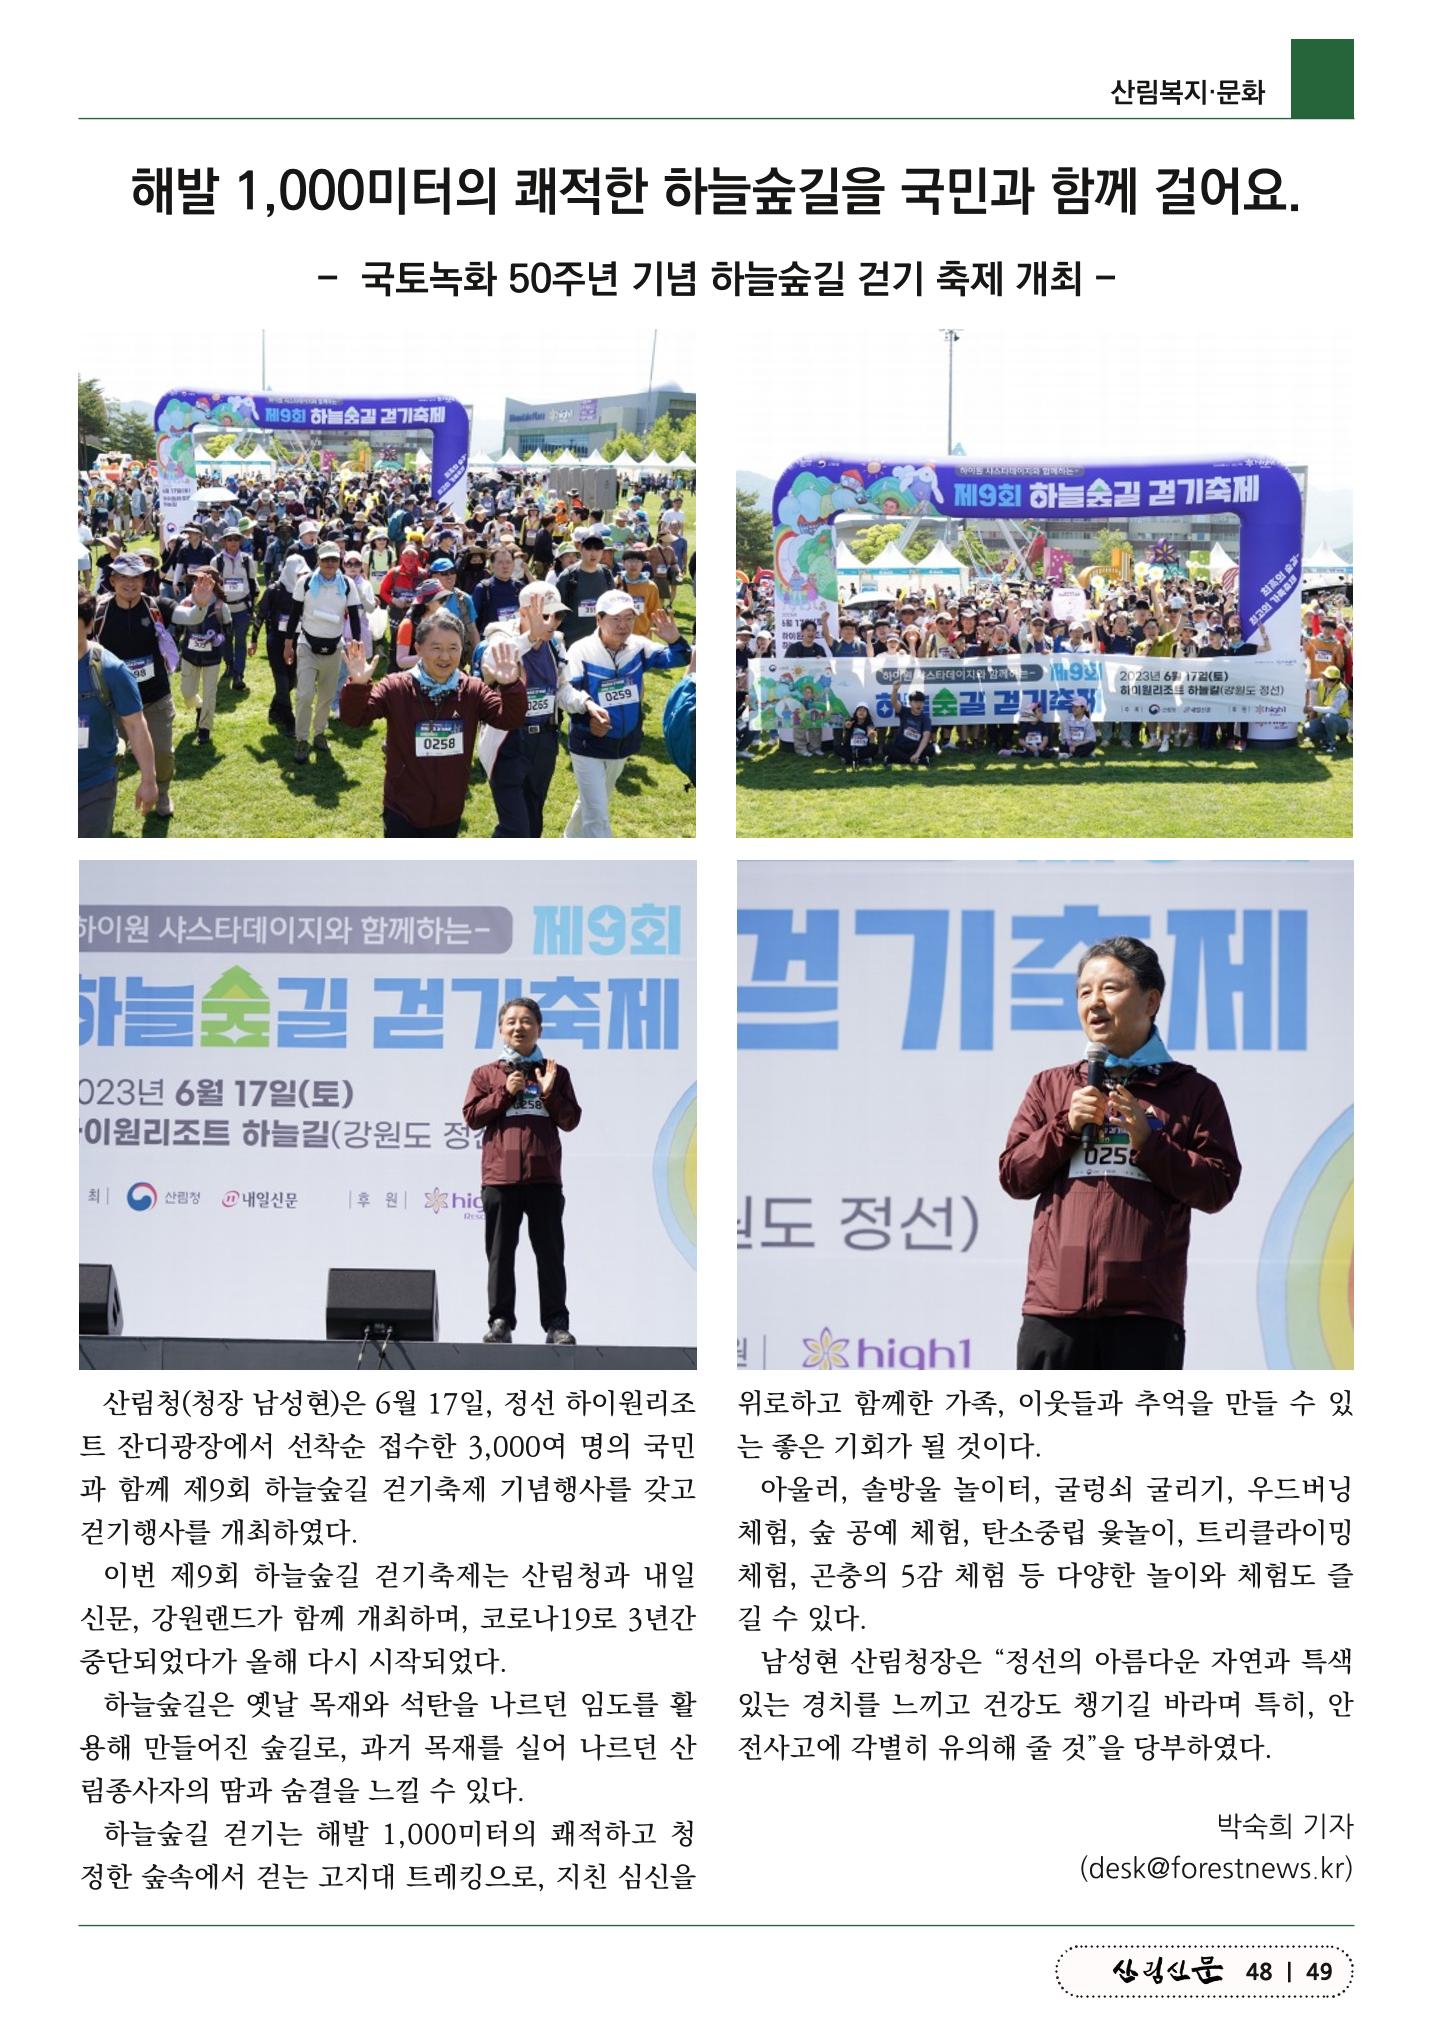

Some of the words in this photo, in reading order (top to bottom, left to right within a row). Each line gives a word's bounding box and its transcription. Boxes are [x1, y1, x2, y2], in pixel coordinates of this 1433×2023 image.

[1110, 79, 1266, 106] 산림복지·문화
[131, 166, 220, 216] 해발
[238, 166, 496, 218] 1,000미터의
[515, 166, 649, 216] 쾌적한
[664, 166, 886, 216] 하늘숲길을
[901, 166, 1036, 216] 국민과
[1051, 166, 1137, 216] 함께
[1155, 166, 1299, 216] 걸어요.
[361, 260, 498, 297] 국토녹화
[509, 260, 618, 297] 50주년
[632, 260, 696, 297] 기념
[711, 260, 844, 297] 하늘숲길
[858, 260, 922, 297] 걷기
[936, 260, 1003, 297] 축제
[1015, 260, 1081, 297] 개최
[265, 408, 306, 423] 제9회
[311, 406, 376, 425] 하늘숲길
[381, 406, 446, 424] 걷기축제
[954, 482, 1021, 507] 제9회
[1029, 478, 1141, 509] 하늘숲길
[1148, 474, 1260, 507] 걷기축제
[1119, 670, 1161, 682] 2023년
[1185, 670, 1229, 682] 17일(토)
[605, 688, 633, 703] 0259
[1259, 685, 1285, 697] 정선)
[424, 738, 456, 750] 0258
[79, 915, 150, 944] 하이원
[158, 915, 352, 945] 샤스타데이지와
[532, 903, 682, 956] 제9회
[737, 904, 1308, 1052] 걷기축제
[79, 964, 349, 1049] 하늘숲길
[372, 975, 680, 1050] 걷기축제
[175, 1079, 224, 1107] 6월
[234, 1079, 354, 1109] 17일(토)
[79, 1118, 231, 1147] 이원리조트
[242, 1119, 431, 1150] 하늘길(강원도
[443, 1121, 485, 1150] 정
[164, 1191, 201, 1205] 산림청
[242, 1191, 299, 1209] 내일신문
[385, 1191, 399, 1208] 원
[452, 1192, 485, 1213] hig
[840, 1195, 979, 1252] 정선)
[857, 1337, 971, 1370] high1
[102, 1389, 244, 1418] 산림청(청장
[252, 1389, 367, 1418] 남성현)은
[375, 1389, 417, 1417] 6월
[429, 1389, 492, 1418] 17일,
[504, 1389, 555, 1417] 정선
[565, 1389, 696, 1417] 하이원리조
[738, 1389, 842, 1417] 위로하고
[854, 1389, 934, 1417] 함께한
[945, 1389, 1004, 1418] 가족,
[1019, 1389, 1124, 1417] 이웃들과
[1135, 1389, 1214, 1417] 추억을
[1225, 1389, 1279, 1417] 만들
[1289, 1389, 1316, 1417] 수
[1329, 1389, 1353, 1417] 있
[79, 1475, 107, 1503] 과
[118, 1475, 169, 1503] 함께
[183, 1475, 249, 1503] 제9회
[264, 1475, 368, 1503] 하늘숲길
[383, 1475, 485, 1503] 걷기축제
[500, 1475, 632, 1503] 기념행사를
[644, 1475, 697, 1503] 갖고
[761, 1475, 847, 1505] 아울러,
[861, 1475, 941, 1503] 솔방울
[953, 1475, 1040, 1505] 놀이터,
[1054, 1475, 1132, 1503] 굴렁쇠
[1146, 1475, 1233, 1505] 굴리기,
[1247, 1475, 1350, 1503] 우드버닝
[737, 1518, 796, 1548] 체험,
[808, 1519, 836, 1546] 숲
[846, 1518, 897, 1546] 공예
[910, 1518, 969, 1548] 체험,
[982, 1518, 1084, 1546] 탄소중립
[1097, 1518, 1183, 1548] 윷놀이,
[1196, 1518, 1351, 1546] 트리클라이밍
[104, 1561, 155, 1589] 이번
[170, 1561, 238, 1589] 제9회
[254, 1561, 359, 1590] 하늘숲길
[375, 1561, 509, 1590] 걷기축제는
[521, 1561, 631, 1590] 산림청과
[643, 1561, 694, 1589] 내일
[79, 1647, 238, 1676] 중단되었다가
[245, 1647, 297, 1675] 올해
[308, 1647, 357, 1675] 다시
[369, 1647, 506, 1676] 시작되었다.
[760, 1647, 838, 1676] 남성현
[850, 1647, 982, 1676] 산림청장은
[995, 1647, 1081, 1676] “정선의
[1095, 1647, 1200, 1675] 아름다운
[1211, 1647, 1291, 1675] 자연과
[1301, 1647, 1352, 1675] 특색
[79, 1733, 130, 1762] 용해
[144, 1733, 248, 1762] 만들어진
[260, 1733, 346, 1763] 숲길로,
[360, 1733, 410, 1762] 과거
[424, 1733, 504, 1762] 목재를
[516, 1733, 565, 1762] 실어
[580, 1733, 657, 1762] 나르던
[670, 1733, 697, 1761] 산
[738, 1733, 840, 1762] 전사고에
[851, 1733, 927, 1761] 각별히
[938, 1733, 1015, 1762] 유의해
[1025, 1735, 1053, 1761] 줄
[1062, 1733, 1125, 1762] 것”을
[1134, 1733, 1271, 1762] 당부하였다.
[103, 1819, 208, 1848] 하늘숲길
[224, 1819, 303, 1848] 걷기는
[316, 1819, 369, 1848] 해발
[384, 1819, 535, 1849] 1,000미터의
[550, 1819, 657, 1848] 쾌적하고
[671, 1819, 694, 1848] 청
[1218, 1812, 1292, 1840] 박숙희
[1304, 1812, 1355, 1840] 기자
[1080, 1854, 1353, 1883] (desk@forestnews.kr)
[1245, 1961, 1273, 1982] 48
[1305, 1962, 1333, 1981] 49
